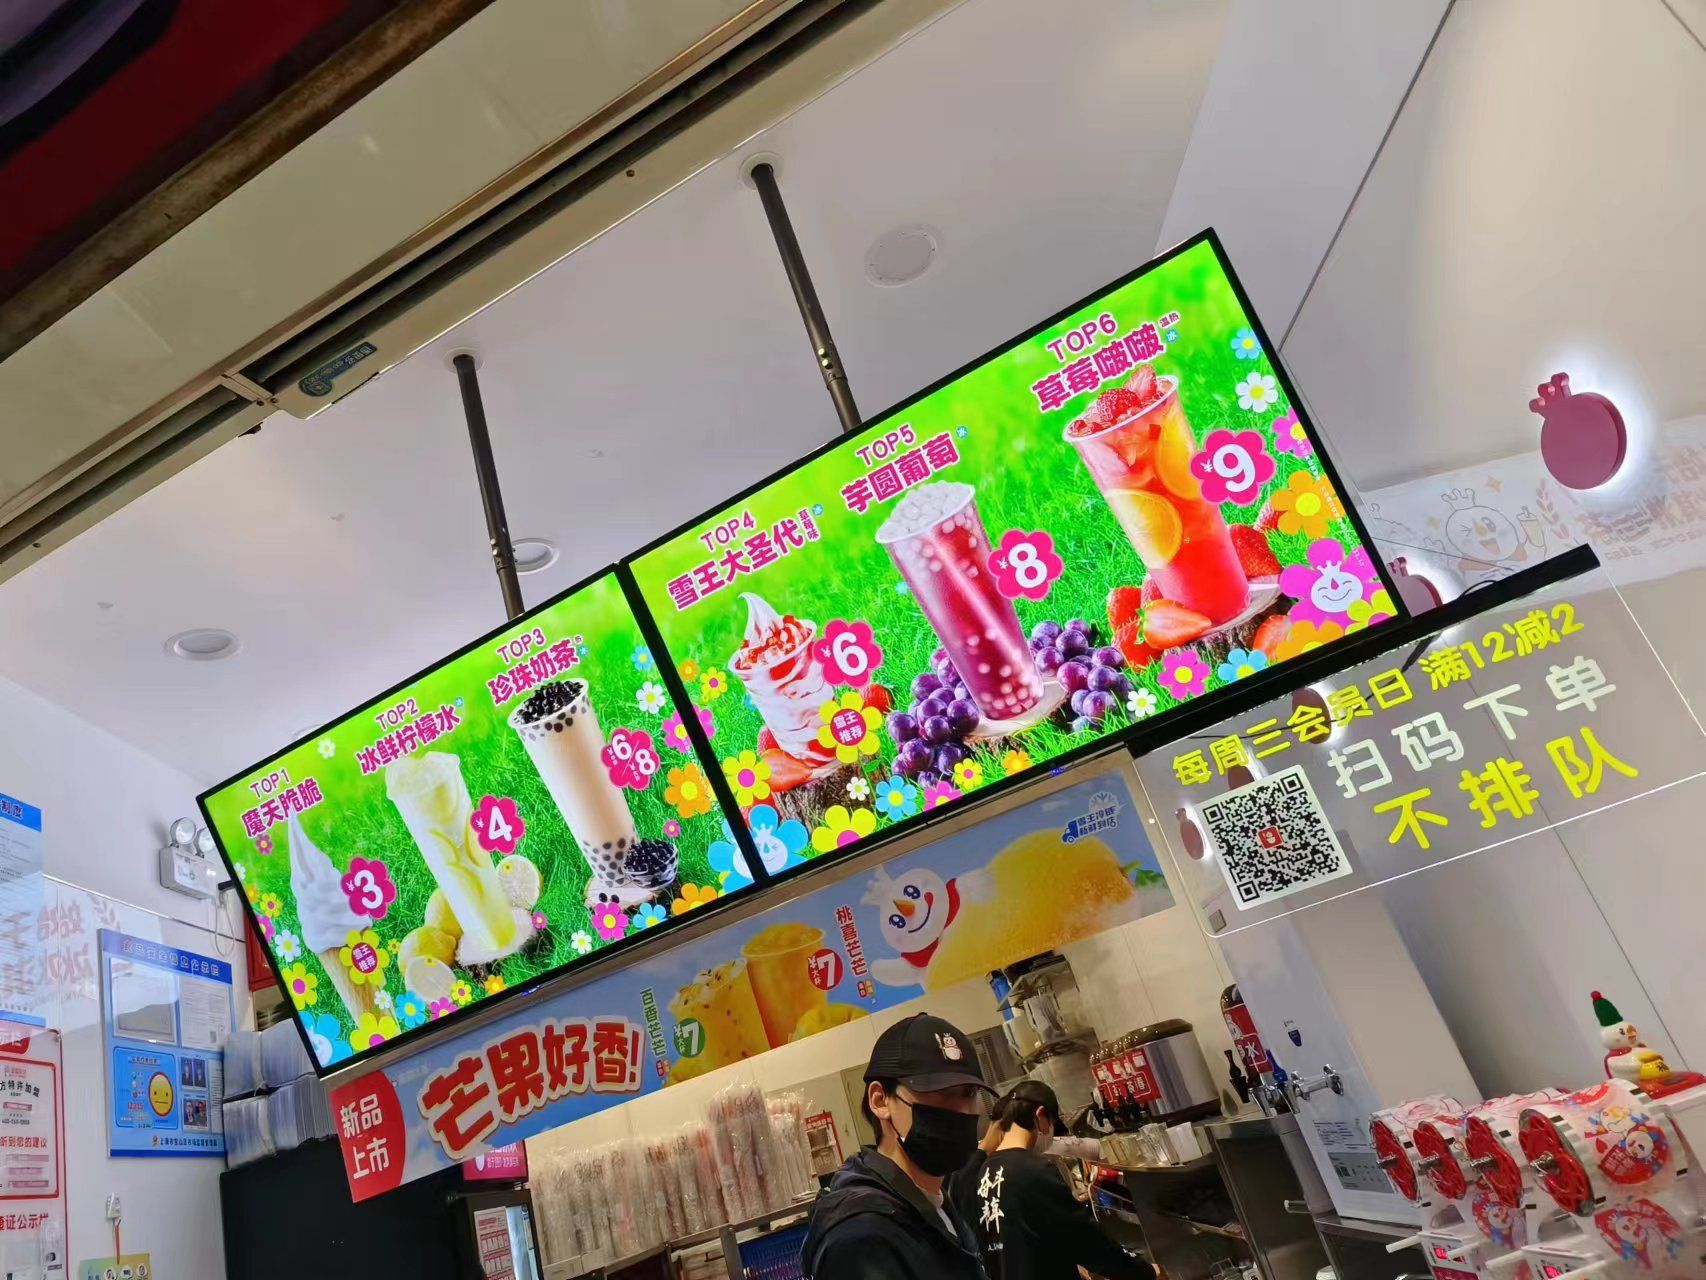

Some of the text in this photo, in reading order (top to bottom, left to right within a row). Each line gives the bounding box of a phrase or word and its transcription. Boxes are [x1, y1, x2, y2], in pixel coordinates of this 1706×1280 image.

[1032, 324, 1164, 411] 草莓啵啵
[1048, 314, 1115, 359] TOP6
[841, 433, 959, 512] 芋圆葡萄
[857, 425, 914, 465] TOP5
[668, 519, 803, 609] 雪王大圣代
[701, 511, 754, 551] TOP4
[488, 640, 578, 704] 珍珠奶茶
[497, 628, 545, 663] TOP3
[1418, 603, 1584, 690] 满12减2
[357, 705, 460, 774] 冰鲜柠檬水
[376, 699, 418, 729] TOP2
[1173, 669, 1413, 785] 每周三会员日
[1328, 656, 1616, 797] 扫码下单
[242, 777, 322, 837] 魔天脆脆
[250, 769, 290, 798] TOP1
[1374, 726, 1639, 848] 不排队
[835, 905, 867, 976] 桃喜芒芒
[641, 988, 666, 1056] 百香芒芒
[340, 1093, 383, 1138] 新品
[353, 1137, 389, 1179] 上市
